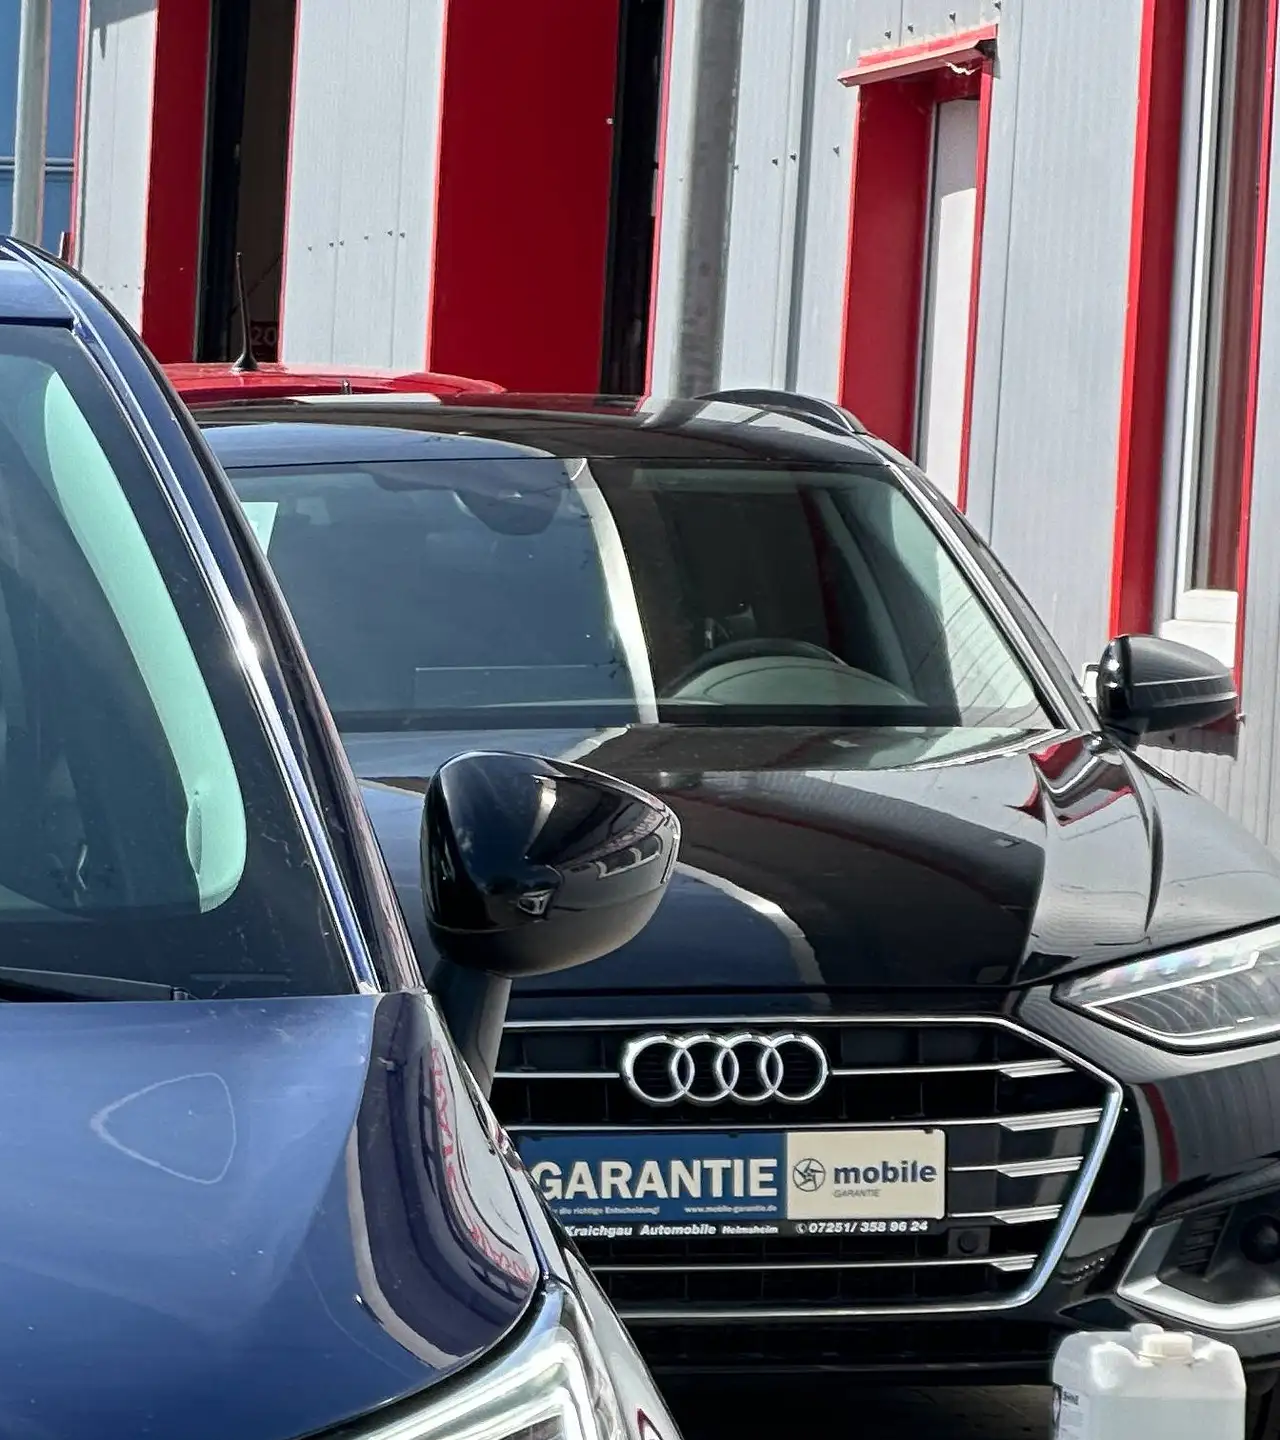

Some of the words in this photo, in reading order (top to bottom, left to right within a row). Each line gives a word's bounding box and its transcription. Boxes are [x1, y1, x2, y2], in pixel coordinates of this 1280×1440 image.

[529, 1157, 778, 1200] GARANTIE
[833, 1160, 938, 1185] mobile
[832, 1188, 881, 1198] GARANTIE
[564, 1224, 633, 1239] Kraichgau
[640, 1223, 717, 1237] Automobile
[721, 1225, 779, 1235] Helmsheim
[859, 1221, 887, 1233] 358
[889, 1220, 908, 1232] 96
[909, 1220, 928, 1232] 24
